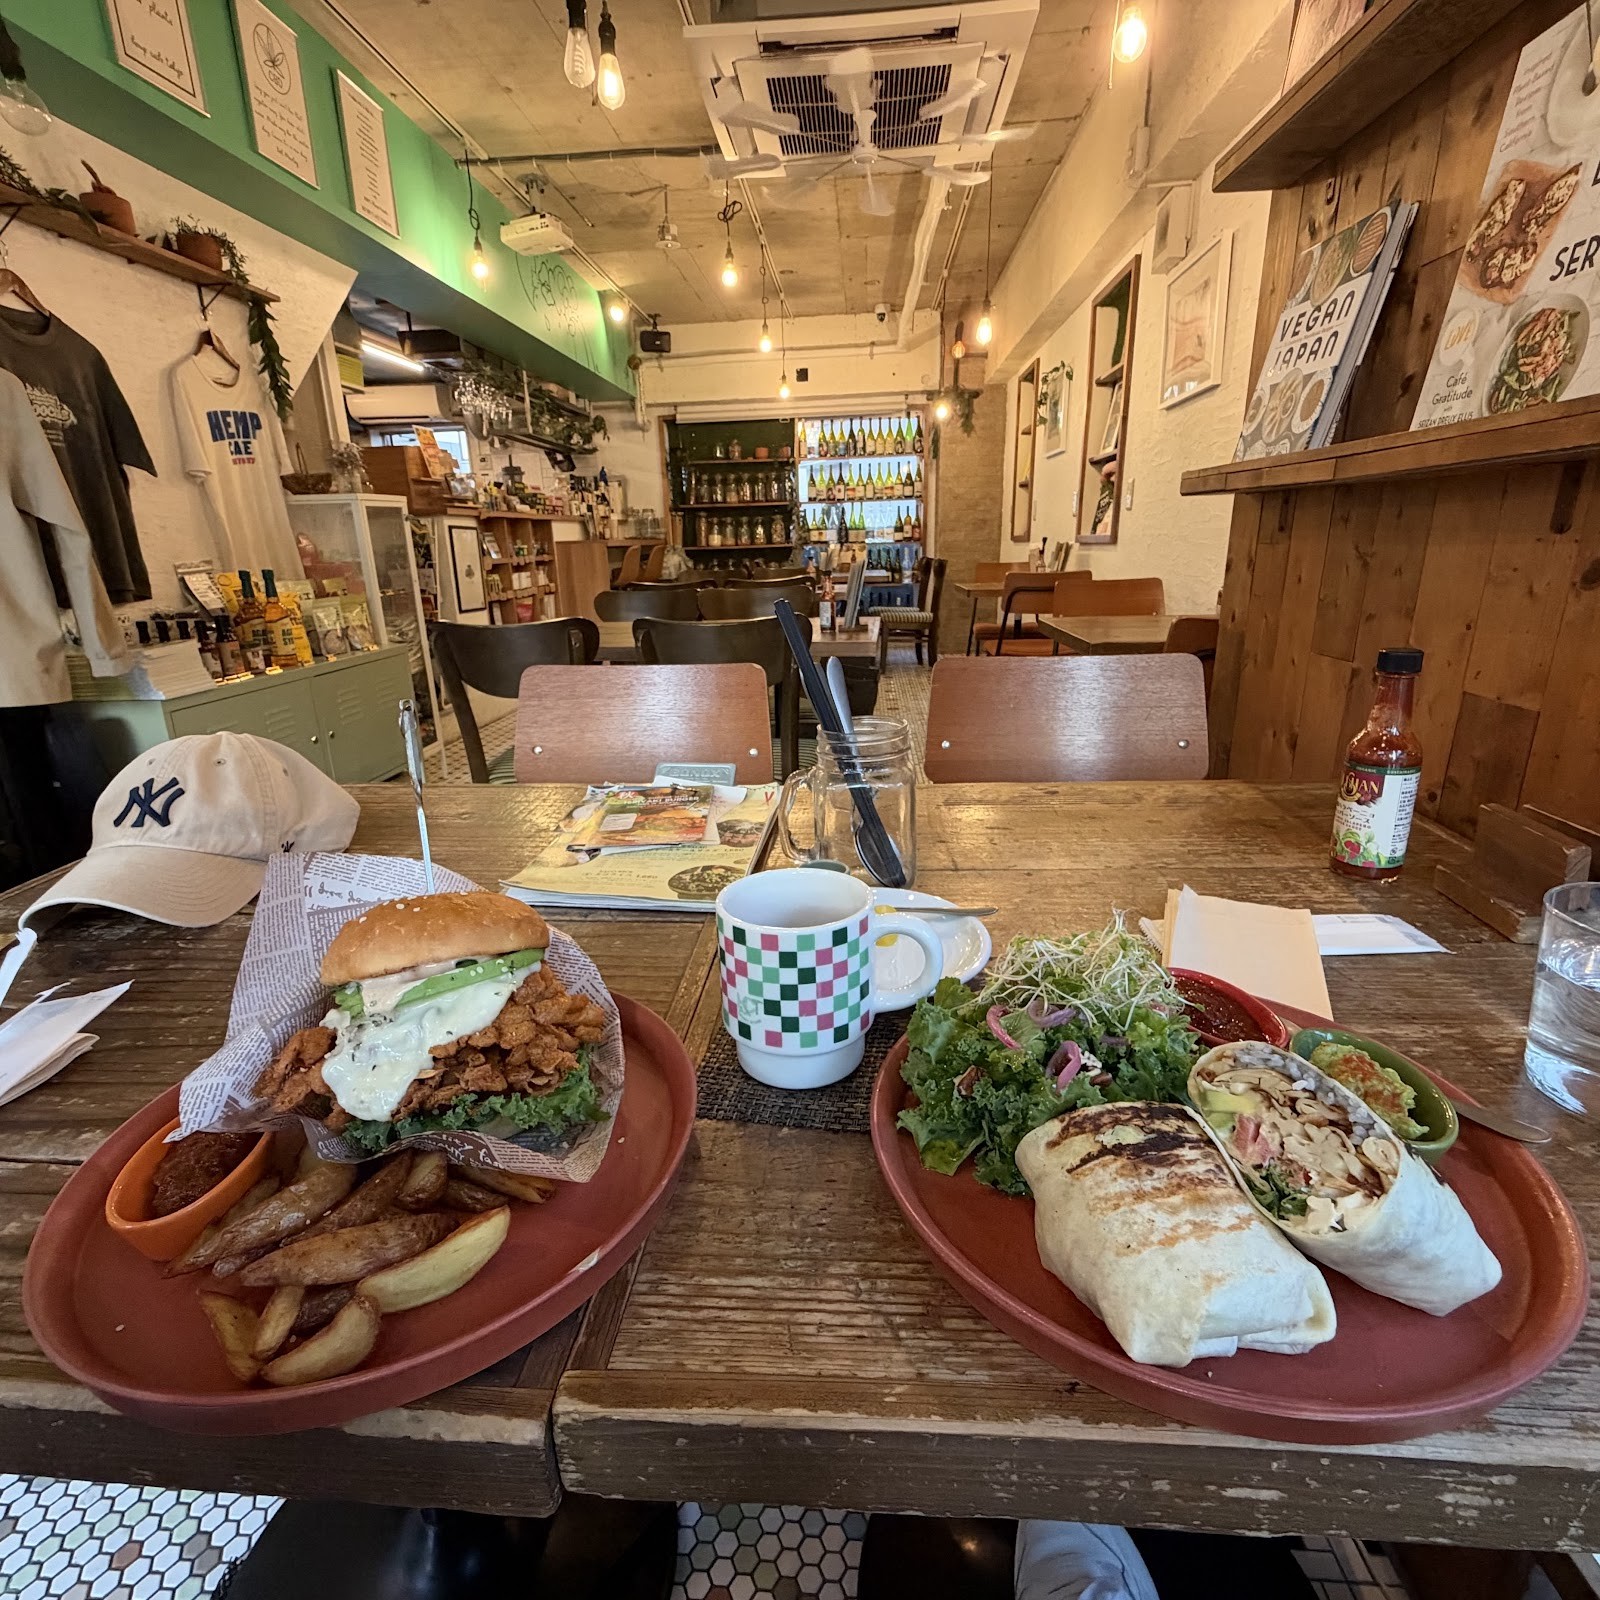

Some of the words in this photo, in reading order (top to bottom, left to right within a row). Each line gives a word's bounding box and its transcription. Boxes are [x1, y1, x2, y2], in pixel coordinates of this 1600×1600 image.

[1279, 290, 1356, 342] VEGAN
[1432, 385, 1474, 405] Gratitude
[1446, 372, 1468, 388] Café
[206, 410, 263, 443] HEMP
[112, 777, 185, 828] NY
